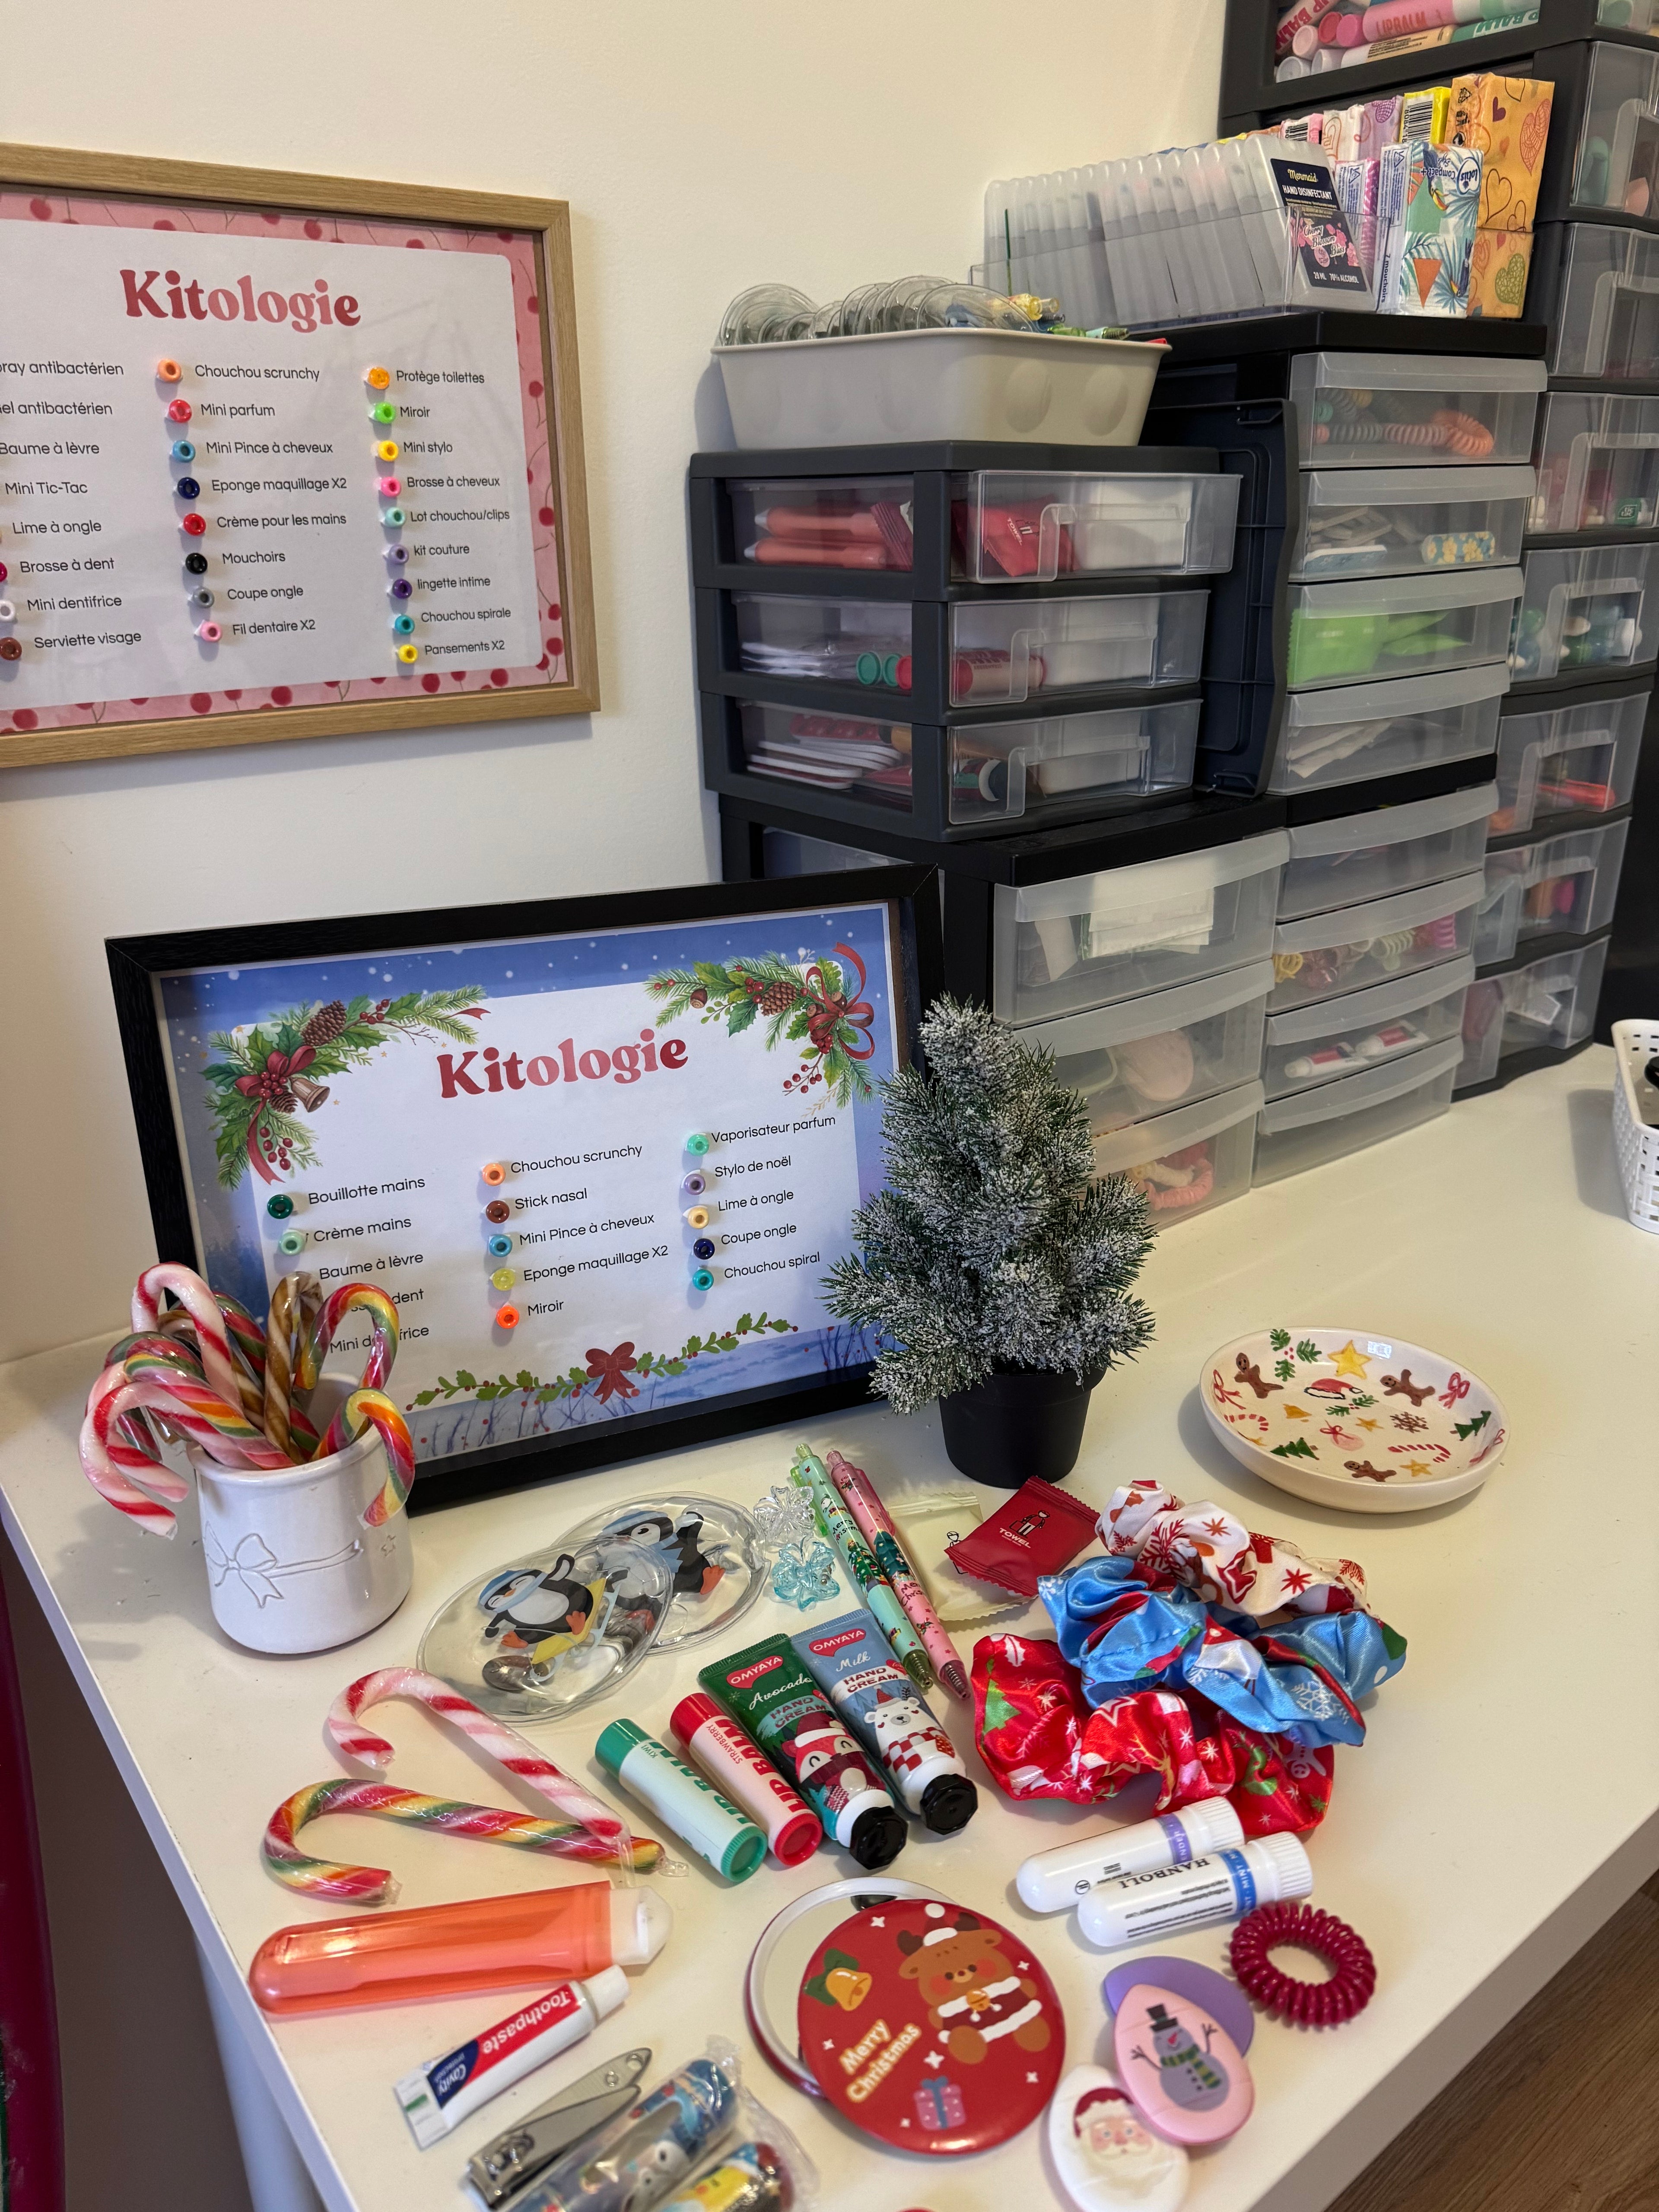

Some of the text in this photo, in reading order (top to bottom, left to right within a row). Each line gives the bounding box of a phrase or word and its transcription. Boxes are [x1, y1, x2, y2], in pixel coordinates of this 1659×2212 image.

[1288, 169, 1317, 182] Mermaid
[1282, 185, 1332, 200] HAND DISINFECTANT
[1303, 225, 1323, 237] Cherry
[1312, 235, 1336, 249] Blossom
[1330, 243, 1346, 257] Bliss
[1340, 274, 1359, 283] ALCOHOL
[120, 269, 361, 333] Kitologie
[0, 361, 124, 376] ray antibactérien
[195, 365, 319, 382] Chouchou scrunchy
[397, 370, 484, 385] Protège toilettes
[18, 401, 112, 414] antibactérien
[201, 404, 275, 419] Mini parfum
[400, 407, 430, 417] Miroir
[0, 442, 99, 454] Baume à lèvre
[207, 442, 333, 453] Mini Pince à cheveux
[404, 442, 452, 455] Mini stylo
[5, 482, 88, 494] Mini Tic-Tac
[212, 478, 347, 493] Eponge maquillage X2
[407, 476, 500, 487] Brosse à cheveux
[217, 514, 346, 529] Crème pour les mains
[411, 509, 509, 522] Lot chouchou/clips
[13, 520, 101, 535] Lime à ongle
[222, 551, 286, 564] Mouchoirs
[414, 544, 469, 556] kit couture
[20, 558, 114, 572] Brosse à dent
[418, 577, 490, 591] lingette intime
[228, 585, 303, 601] Coupe ongle
[27, 595, 121, 611] Mini dentifrice
[421, 608, 511, 622] Chouchou spirale
[233, 620, 315, 635] Fil dentaire X2
[35, 632, 141, 648] Serviette visage
[425, 640, 505, 655] Pansements X2
[437, 1028, 688, 1098] Kitologie
[711, 1117, 835, 1143] Vaporisateur parfum
[511, 1145, 642, 1173] Chouchou scrunchy
[715, 1155, 791, 1178] Stylo de noël
[308, 1179, 425, 1204] Bouillotte mains
[515, 1188, 587, 1209] Stick nasal
[718, 1190, 794, 1211] Lime à ongle
[314, 1227, 364, 1241] Crème
[368, 1219, 411, 1233] mains
[520, 1215, 655, 1245] Mini Pince à cheveux
[721, 1224, 796, 1245] Coupe ongle
[320, 1255, 423, 1279] Baume à lèvre
[524, 1246, 668, 1282] Eponge maquillage X2
[725, 1252, 820, 1278] Chouchou spiral
[392, 1288, 424, 1304] dent
[528, 1300, 564, 1316] Miroir
[330, 1327, 429, 1353] Mini dfrice
[832, 1519, 854, 1535] Merry
[998, 1527, 1032, 1549] TOWEL
[813, 1629, 865, 1652] OMYAYA
[836, 1650, 871, 1672] Milk
[730, 1656, 783, 1684] OMYAYA
[843, 1667, 888, 1685] HAND
[847, 1673, 899, 1693] CREAM
[749, 1676, 813, 1710] Avocado
[770, 1697, 814, 1720] HAND
[774, 1703, 827, 1729] CREAM
[641, 1745, 658, 1759] KIWI
[706, 1725, 743, 1764] STRAWBERRY
[715, 1718, 808, 1814] LIP BALM
[1121, 1858, 1211, 1889] HANBOLI
[1236, 1865, 1250, 1889] MINT
[483, 1990, 571, 2054] Toothpaste
[839, 2018, 892, 2075] Merry
[845, 2022, 922, 2103] Christmas
[438, 2063, 467, 2095] Cavity
